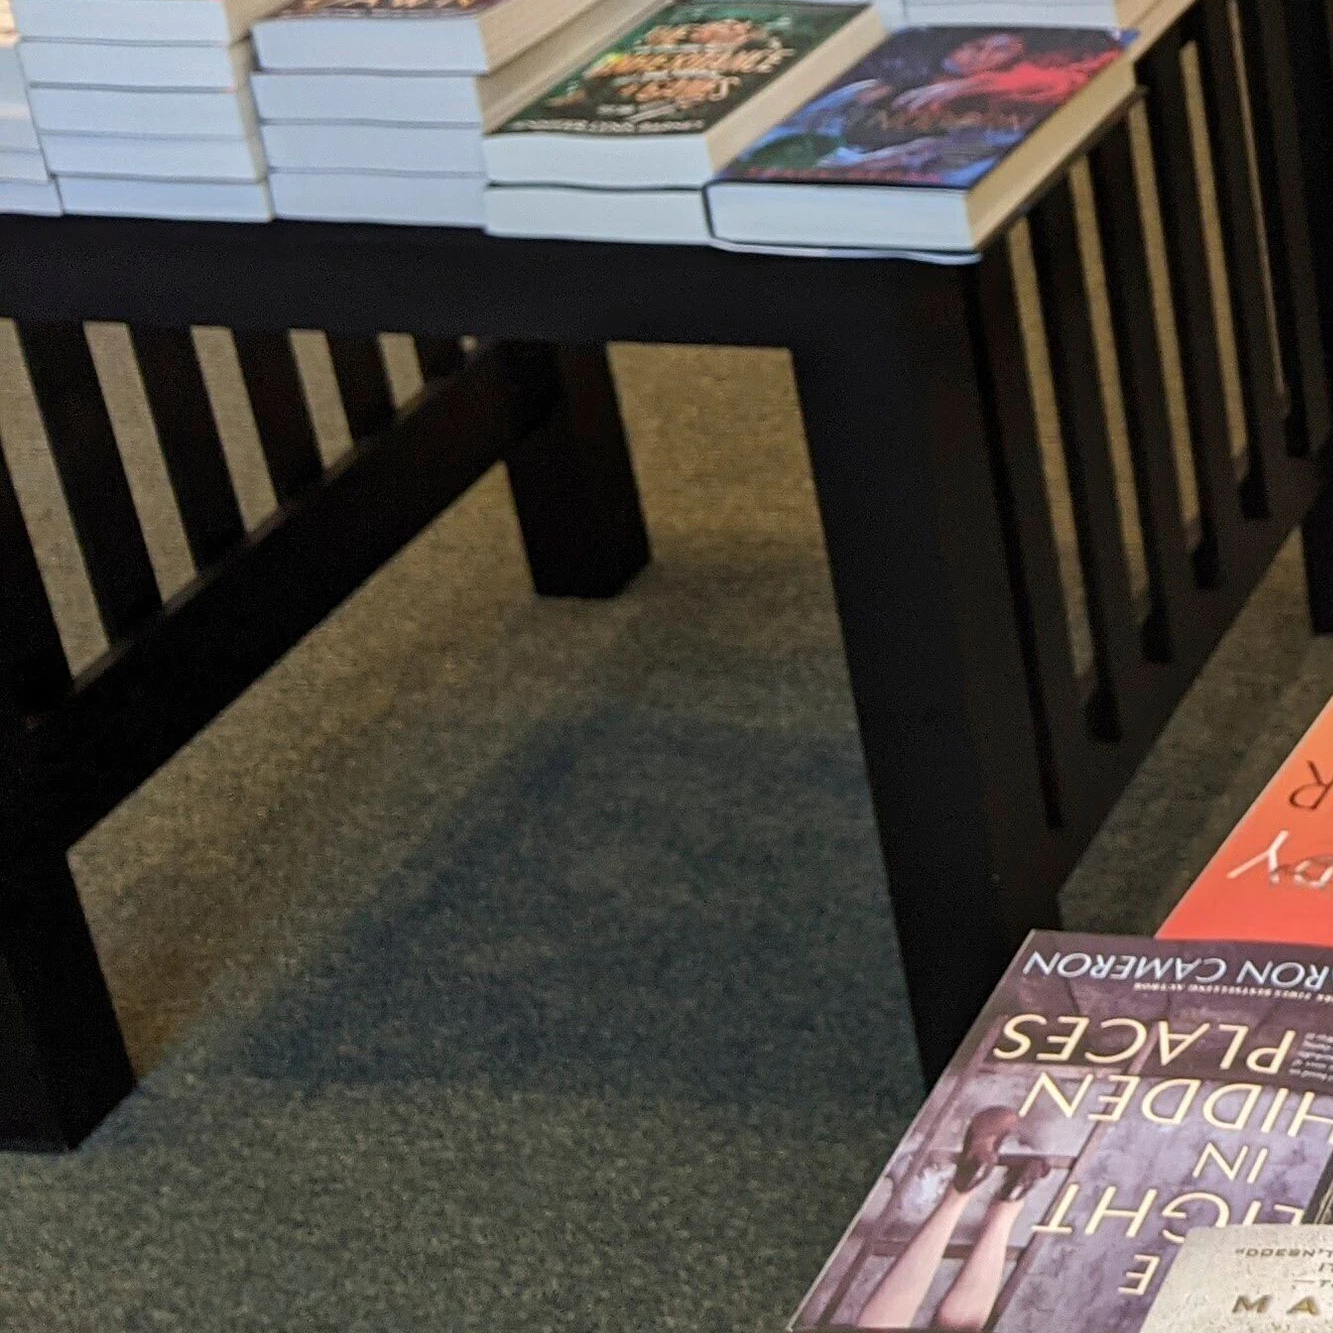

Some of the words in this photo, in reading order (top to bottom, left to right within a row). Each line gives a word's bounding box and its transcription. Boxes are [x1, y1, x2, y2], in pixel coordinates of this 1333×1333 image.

[1022, 950, 1228, 983] CAMERON
[992, 1013, 1297, 1075] PLACES
[1190, 1142, 1269, 1185] IN
